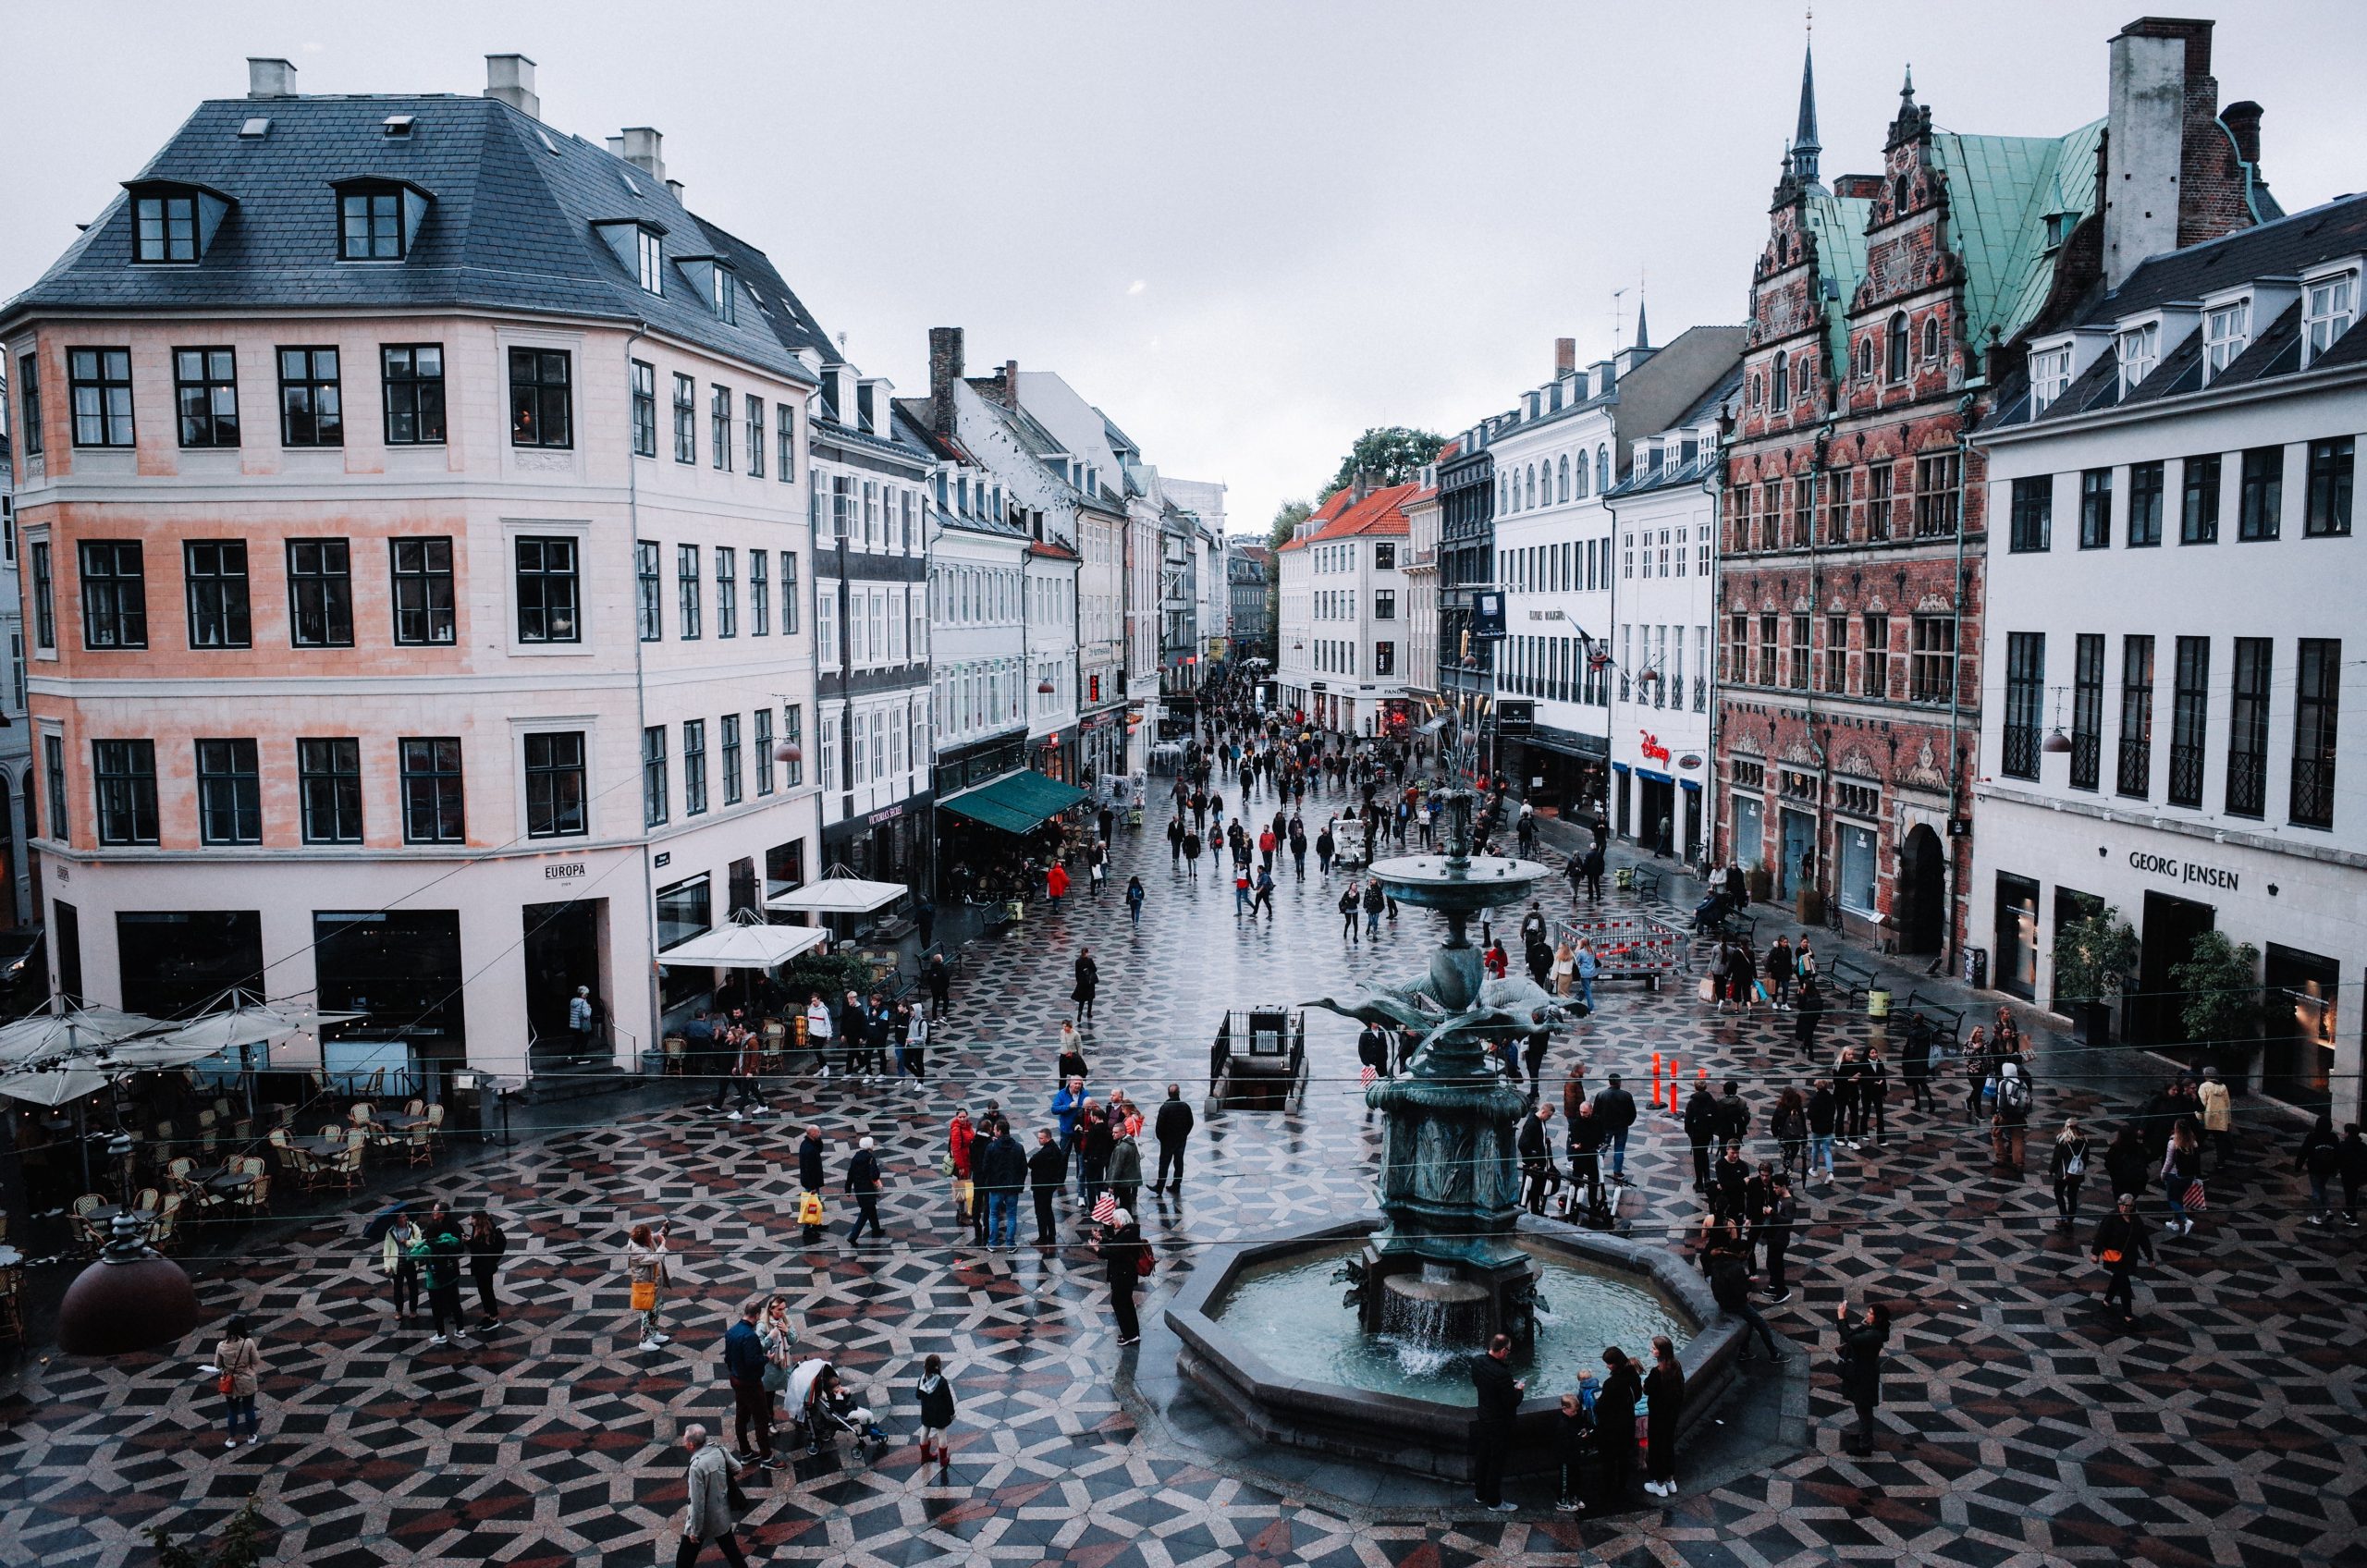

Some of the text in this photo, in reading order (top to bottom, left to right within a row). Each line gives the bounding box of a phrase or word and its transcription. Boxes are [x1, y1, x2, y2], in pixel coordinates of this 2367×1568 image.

[1727, 702, 1767, 717] ROYAL
[1640, 729, 1670, 770] Disney
[868, 804, 902, 826] VICTORIA'S SECRET
[545, 864, 585, 878] EUROPA
[2129, 851, 2238, 890] GEORG JENSEN
